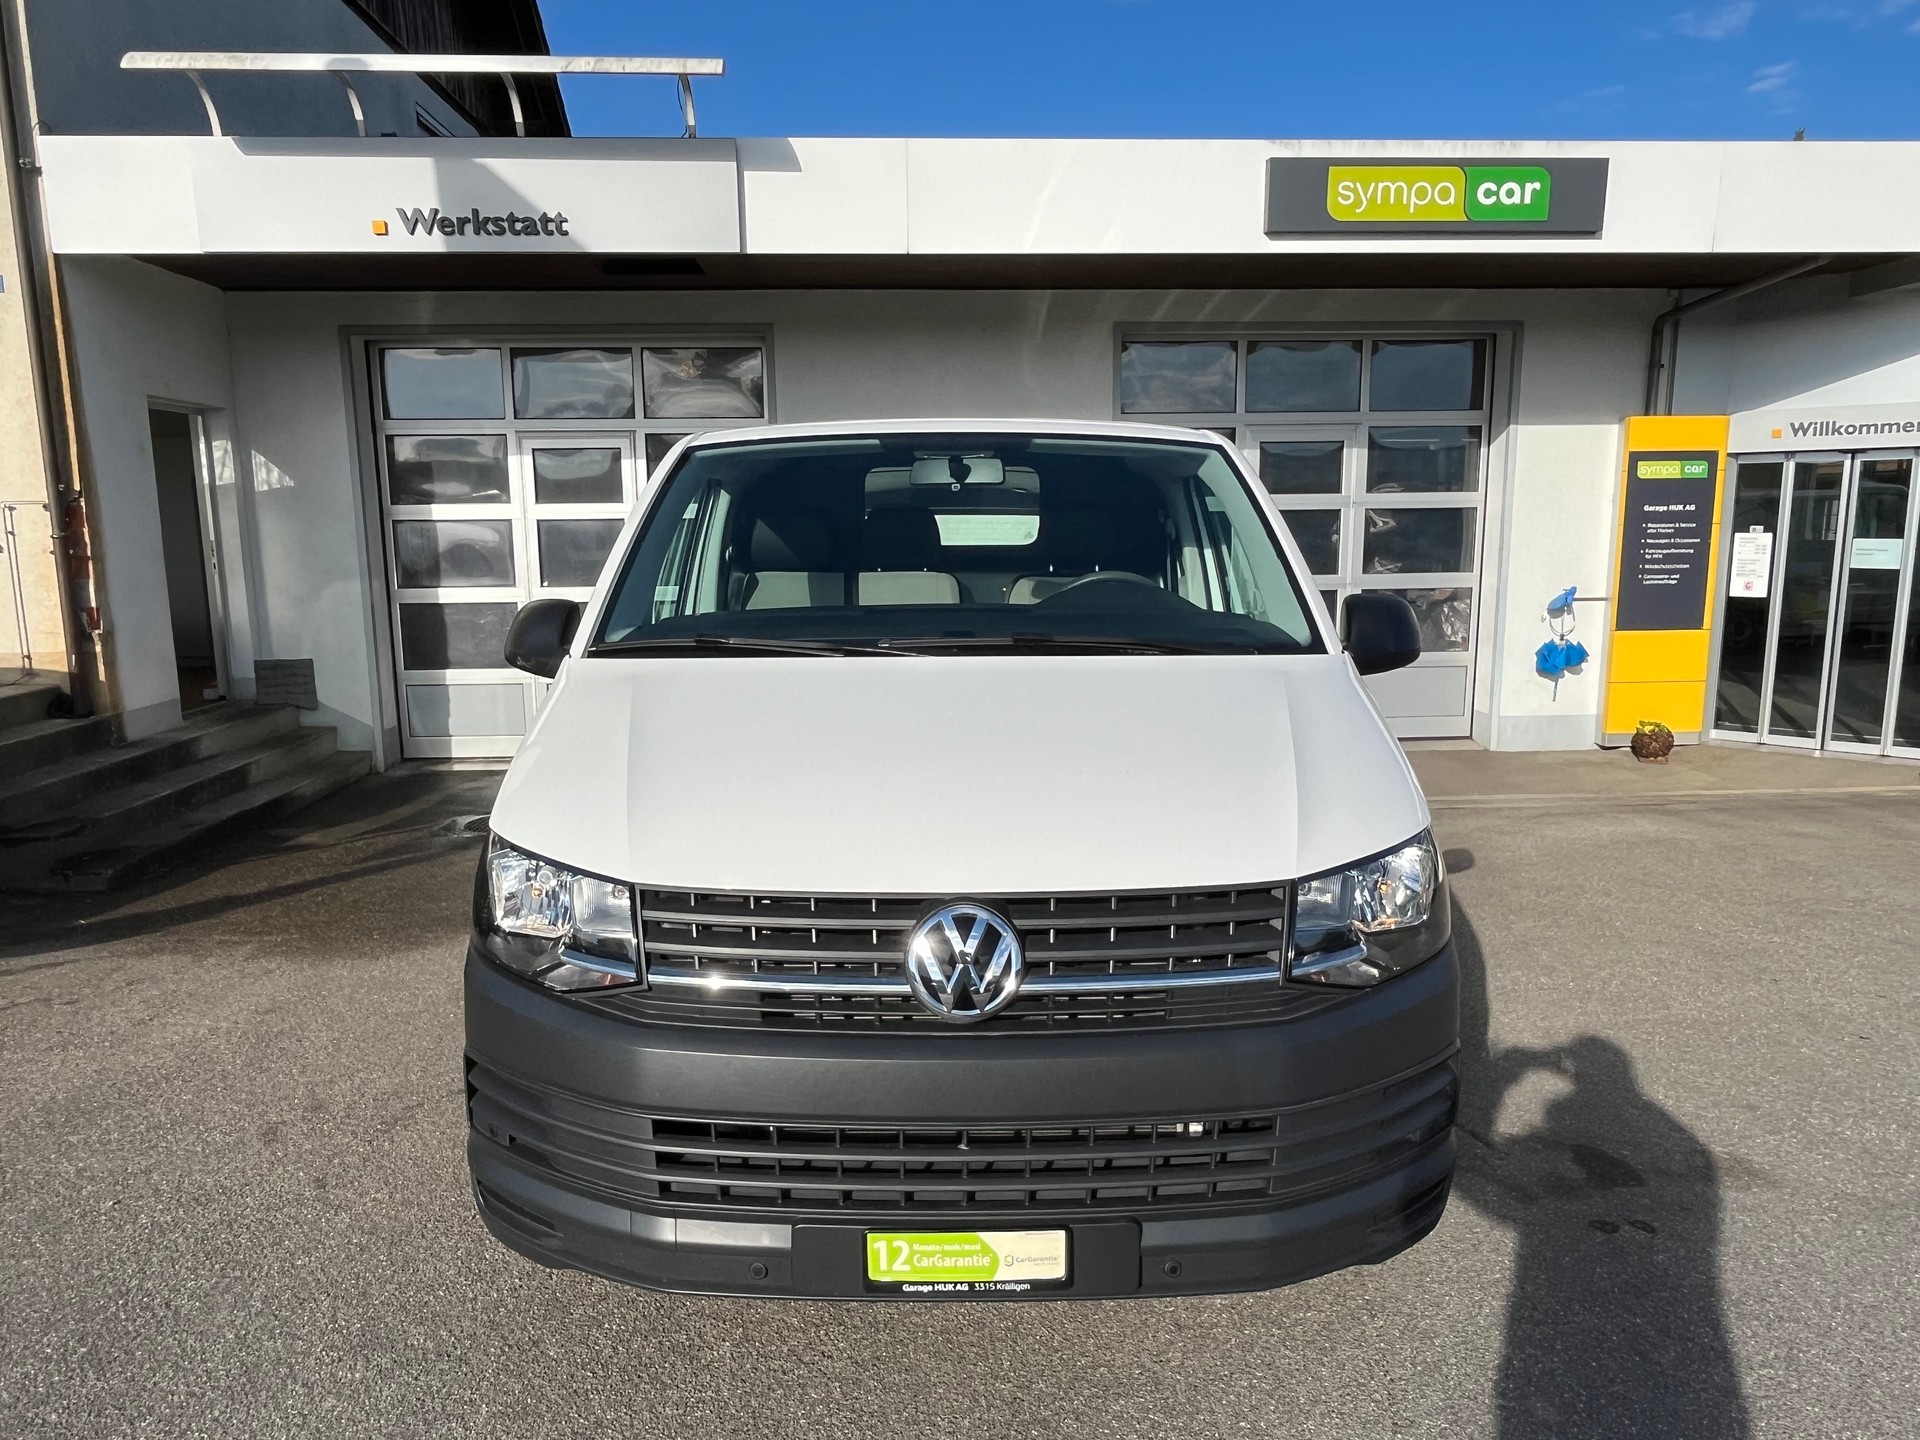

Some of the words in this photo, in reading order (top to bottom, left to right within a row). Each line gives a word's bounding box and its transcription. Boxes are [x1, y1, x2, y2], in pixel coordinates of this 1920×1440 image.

[1337, 181, 1456, 213] sympa
[1476, 181, 1542, 205] car
[396, 207, 570, 237] Werkstatt
[1640, 465, 1679, 476] sympa
[1684, 465, 1706, 474] car
[1643, 504, 1668, 512] Garage
[873, 1239, 911, 1271] 12
[902, 1283, 933, 1293] Garage
[934, 1283, 955, 1291] HUK
[955, 1283, 969, 1291] AG
[974, 1282, 996, 1291] 3315
